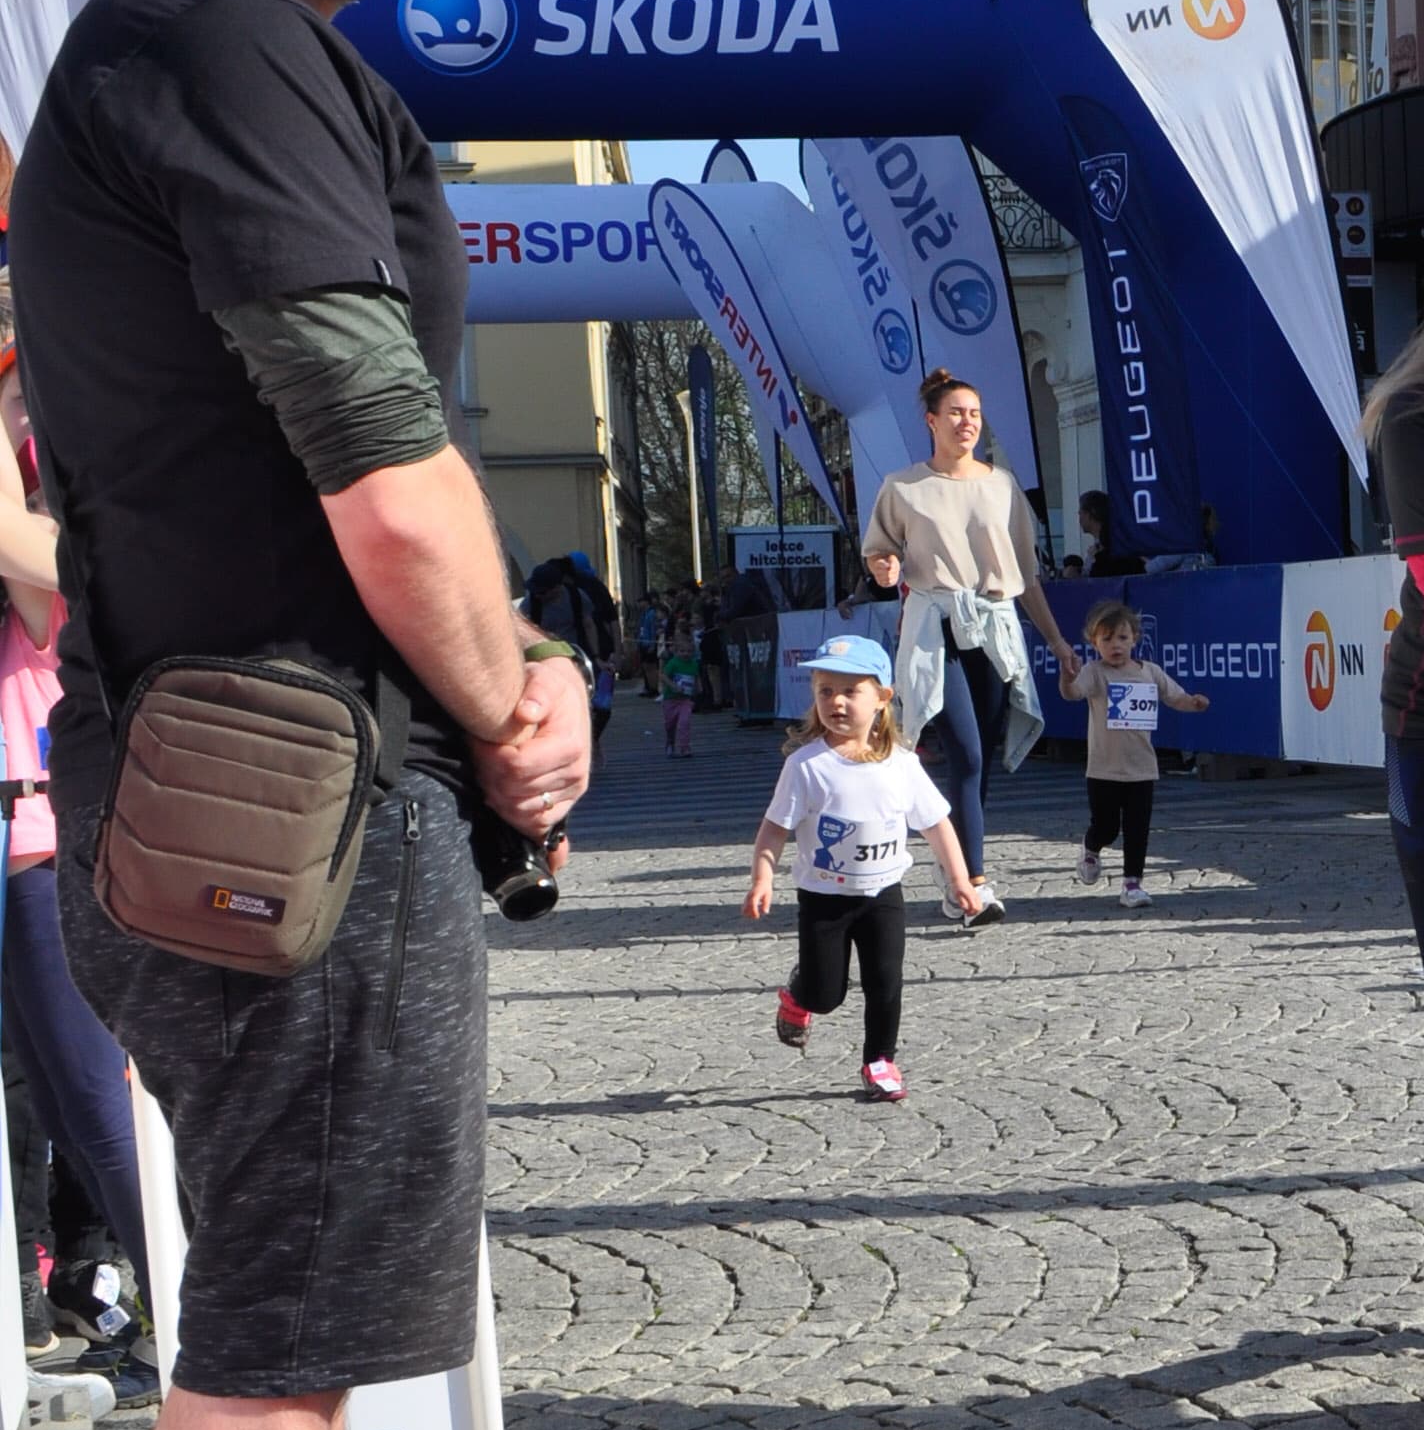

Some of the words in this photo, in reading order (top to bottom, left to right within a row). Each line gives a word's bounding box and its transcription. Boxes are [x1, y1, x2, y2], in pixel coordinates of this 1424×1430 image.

[1103, 238, 1159, 524] PEUGEOT
[766, 540, 805, 552] lekce
[1162, 643, 1278, 679] PEUGEOT
[1339, 643, 1364, 676] NN
[853, 839, 898, 862] 3171
